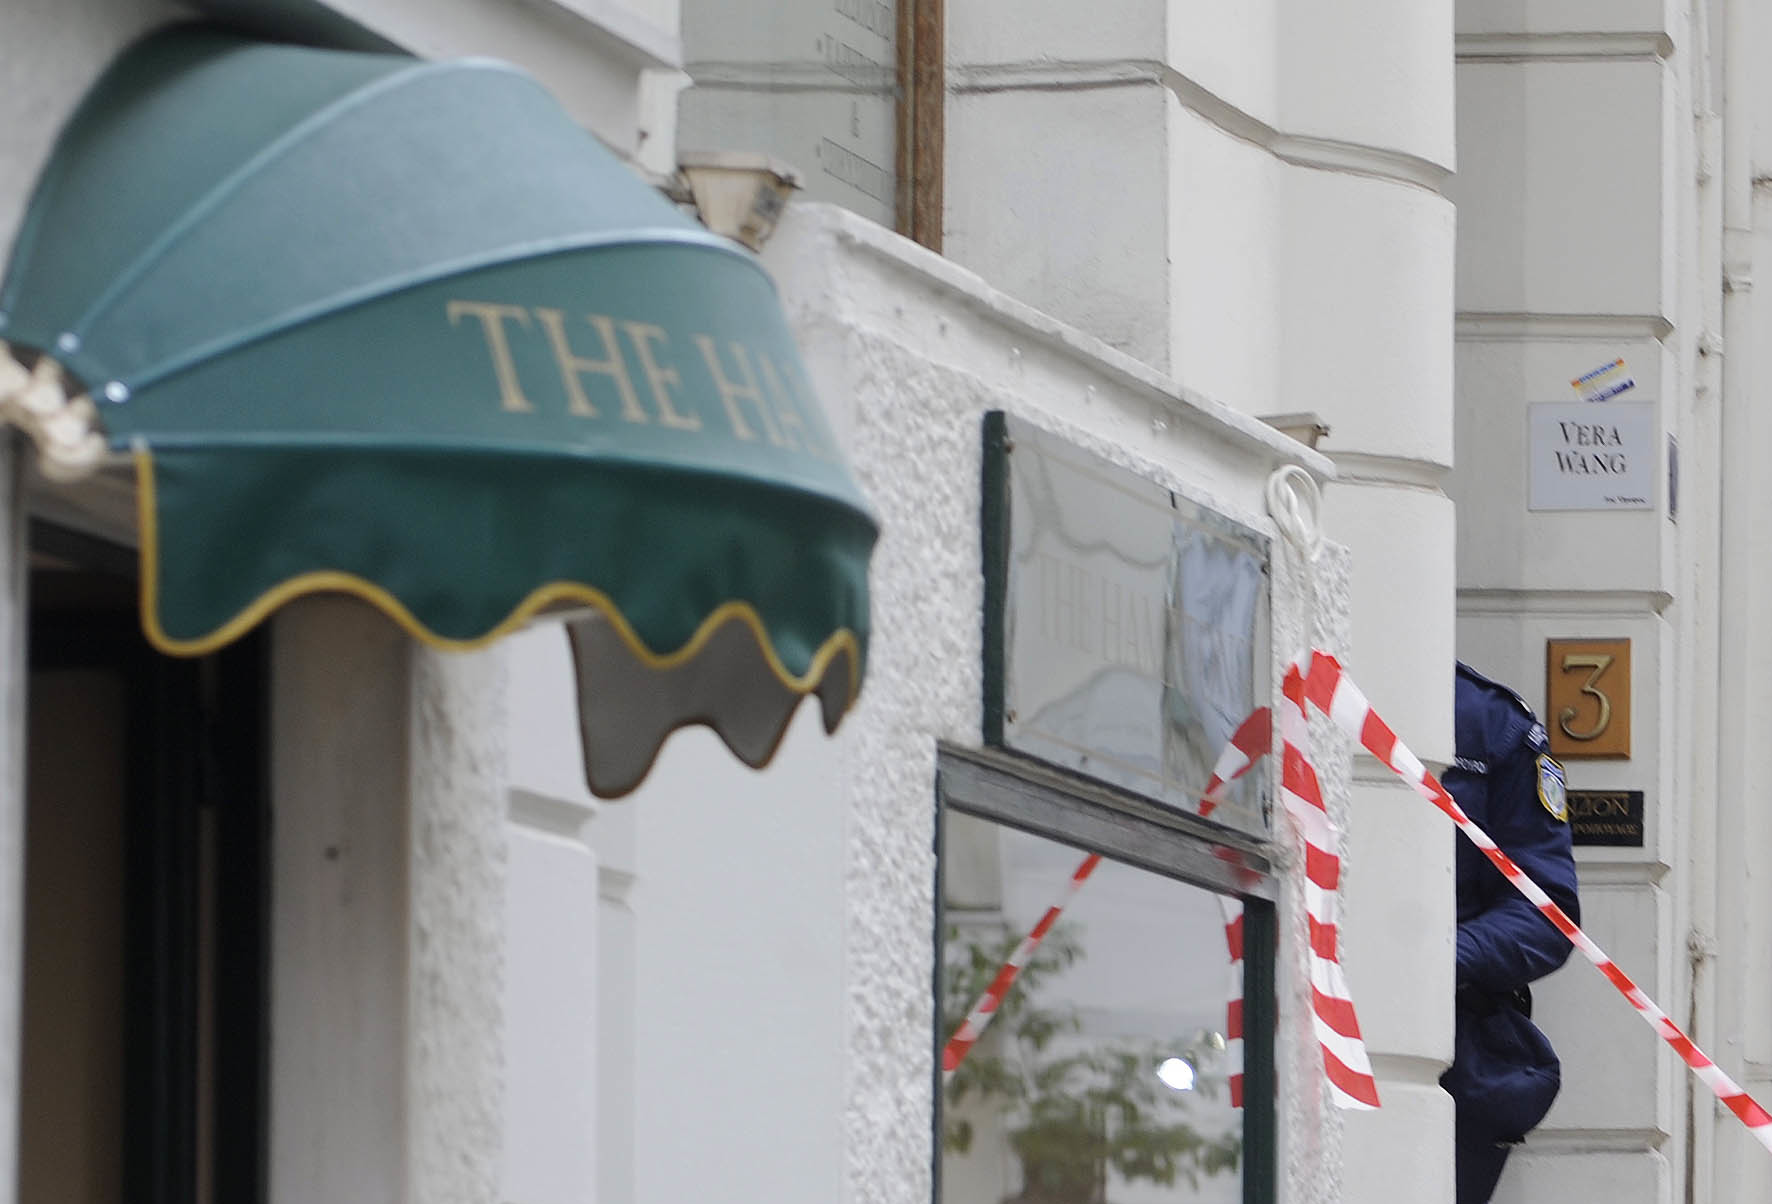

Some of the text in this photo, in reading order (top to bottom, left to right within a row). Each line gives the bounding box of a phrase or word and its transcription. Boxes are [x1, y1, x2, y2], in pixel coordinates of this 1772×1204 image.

[446, 299, 703, 433] THE
[1559, 421, 1624, 447] VERA
[1555, 450, 1628, 476] WANG
[1558, 653, 1614, 742] 3
